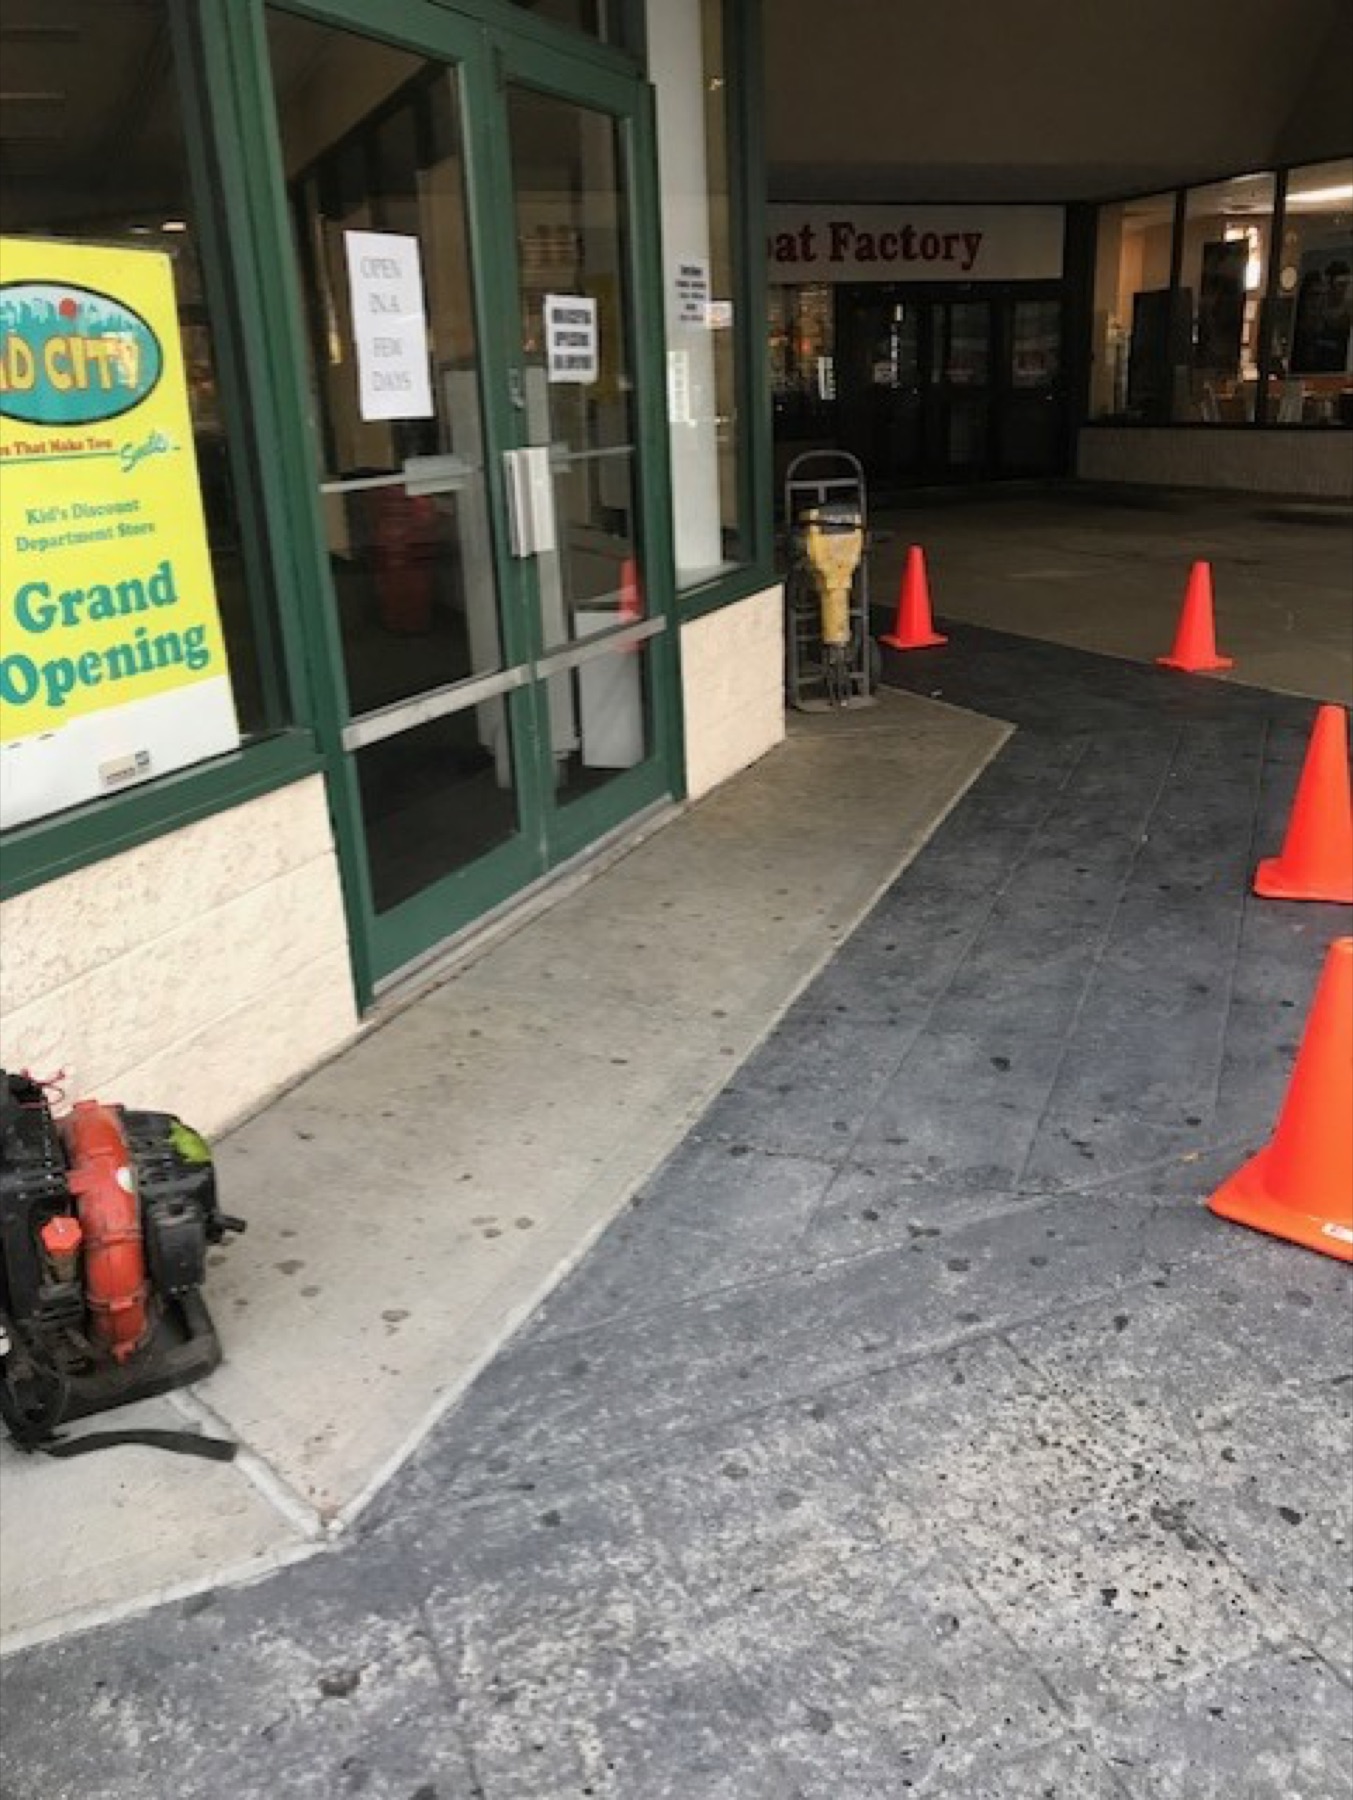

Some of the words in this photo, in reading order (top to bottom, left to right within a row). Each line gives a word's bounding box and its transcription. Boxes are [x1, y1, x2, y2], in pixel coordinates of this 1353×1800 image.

[827, 220, 983, 271] Factory
[360, 256, 403, 280] OPEN
[44, 332, 141, 393] CITY
[14, 440, 46, 455] That
[26, 505, 69, 525] Kid's
[72, 499, 141, 521] Discount
[15, 525, 113, 552] Department
[117, 521, 156, 538] Store
[13, 559, 179, 634] Grand
[0, 624, 211, 707] Opening
